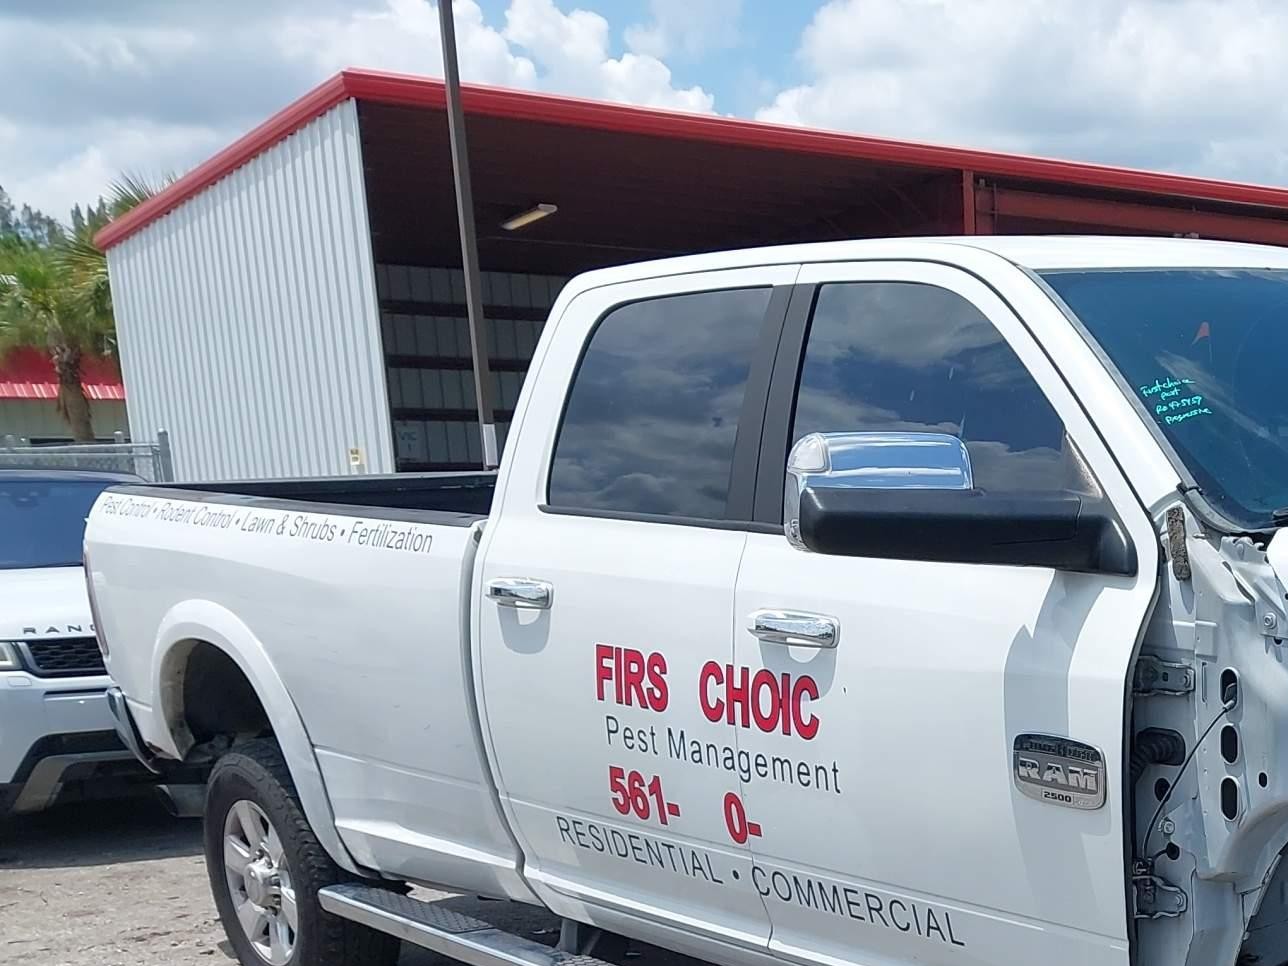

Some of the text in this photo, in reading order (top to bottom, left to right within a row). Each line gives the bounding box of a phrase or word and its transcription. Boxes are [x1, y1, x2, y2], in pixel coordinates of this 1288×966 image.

[102, 496, 121, 515] Pest
[119, 498, 152, 517] Control
[157, 502, 195, 525] Rodent
[193, 506, 235, 529] Control
[240, 511, 275, 534] Lawn
[276, 514, 290, 536] &
[289, 515, 338, 542] Shrubs
[348, 520, 434, 553] Fertilization
[594, 643, 821, 741] FIRS CHOIC
[605, 714, 842, 795] Pest Management
[1018, 757, 1098, 791] RAM
[608, 765, 764, 845] 561- 0-
[1043, 791, 1072, 803] 2500
[556, 815, 724, 885] RESIDENTIAL
[751, 865, 967, 947] COMMERCIAL
